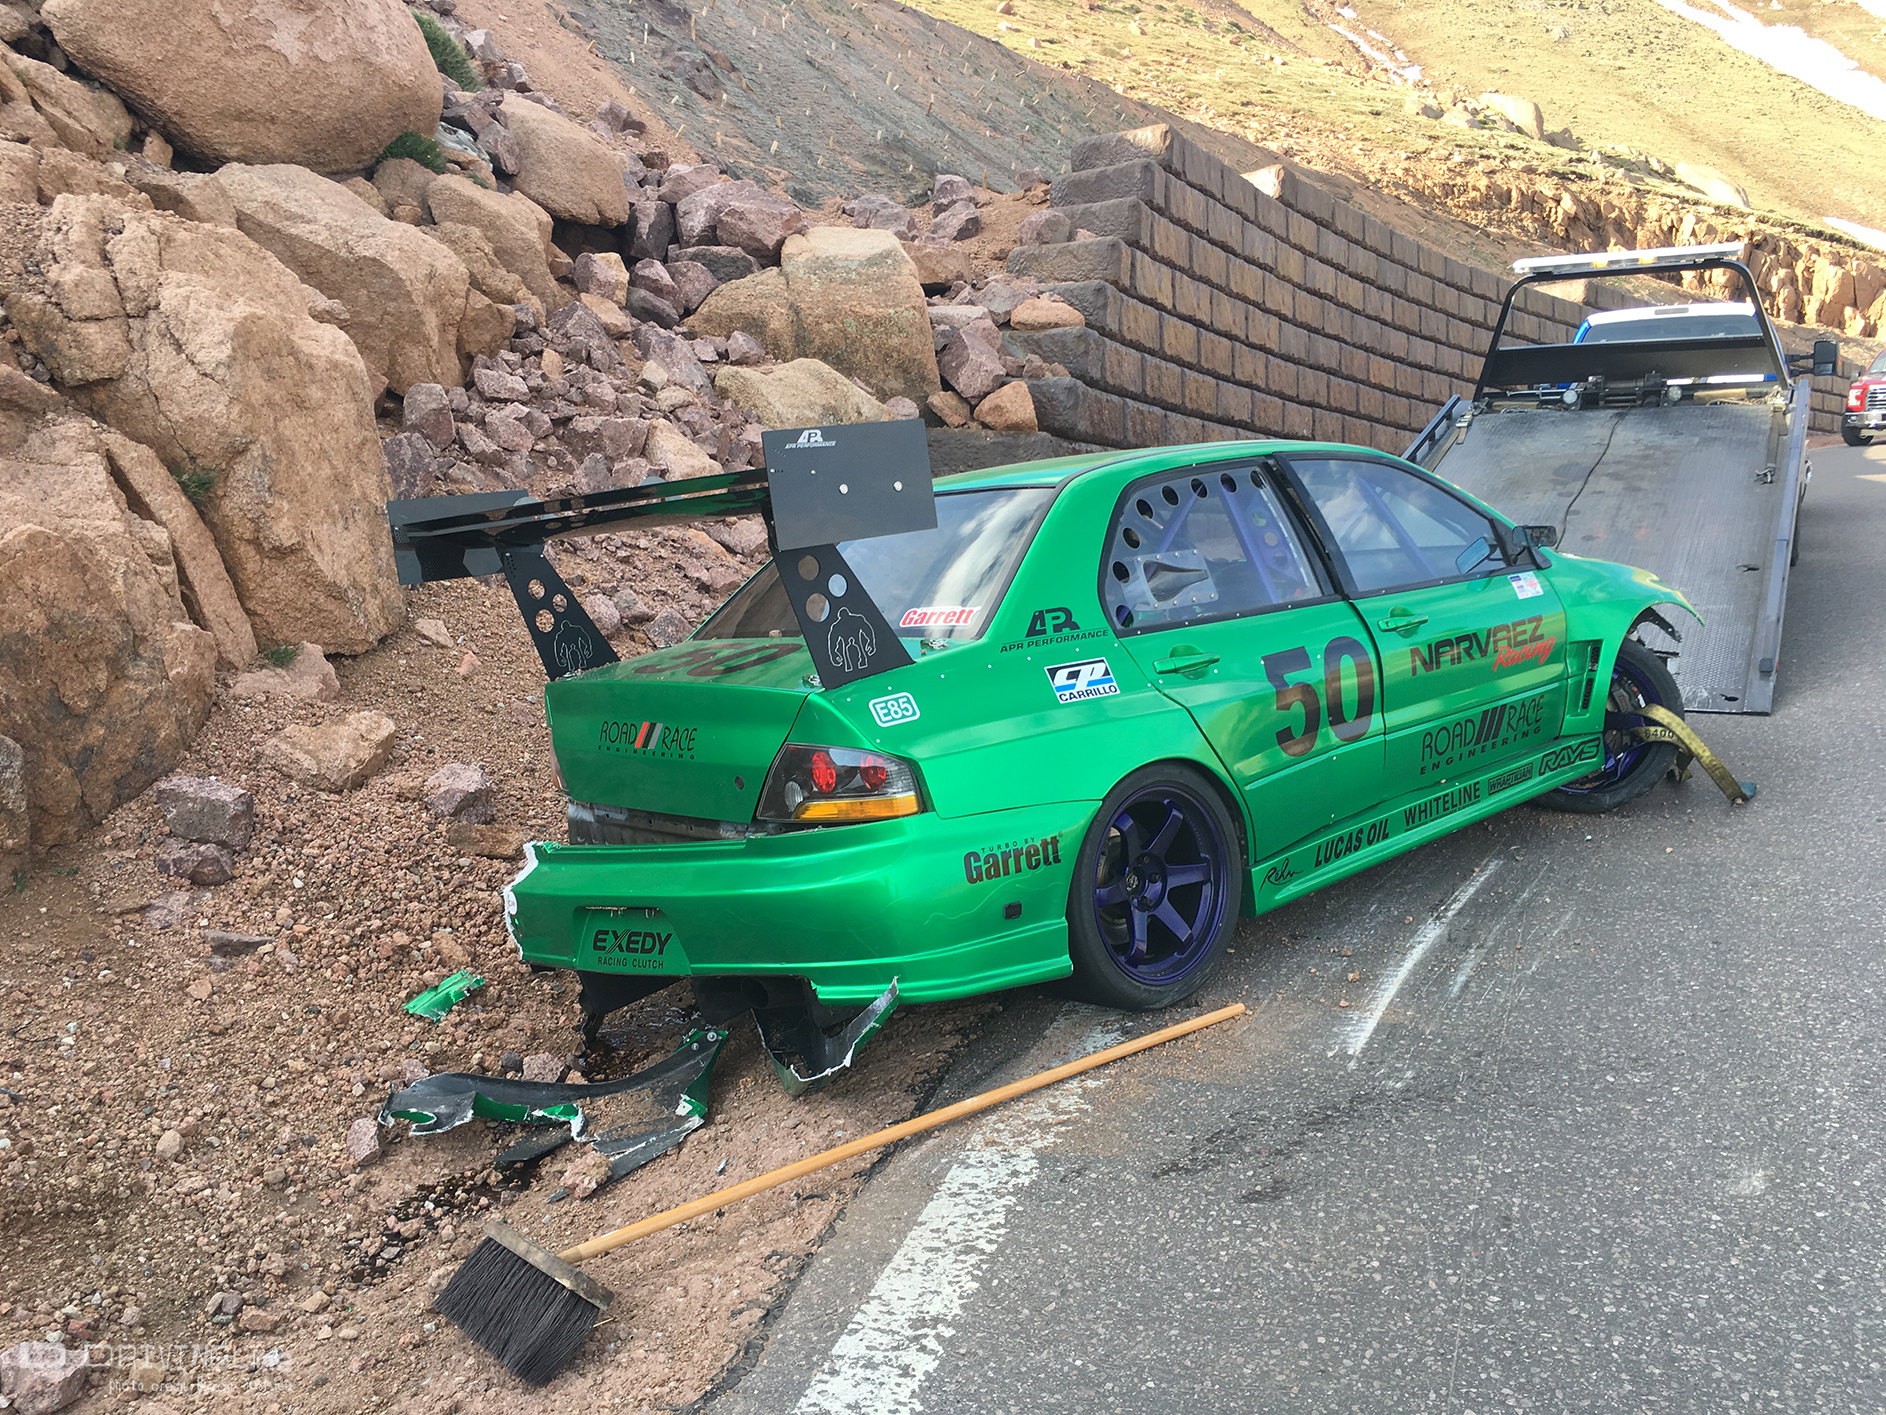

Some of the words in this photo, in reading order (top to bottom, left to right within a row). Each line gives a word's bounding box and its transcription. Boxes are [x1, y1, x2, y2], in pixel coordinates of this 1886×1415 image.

[901, 608, 975, 627] Garrett
[1025, 606, 1082, 639] APR
[999, 641, 1024, 653] APR
[1027, 629, 1109, 649] PERFORMANCE
[1409, 613, 1545, 677] NARVAEZ
[1492, 637, 1557, 673] Racing
[633, 642, 804, 677] 50
[874, 697, 914, 722] E85
[1058, 684, 1118, 702] CARRILLO
[1260, 635, 1375, 757] 50
[599, 720, 638, 745] ROAD
[661, 725, 698, 751] RACE
[1421, 718, 1476, 762] ROAD
[1505, 694, 1545, 734] RACE
[598, 744, 695, 760] ENGINEERING
[1419, 725, 1541, 776] ENGINEERING
[1538, 736, 1601, 777] RAYS
[1404, 781, 1480, 827] WHITELINE
[963, 836, 1061, 884] Garrett
[981, 840, 1018, 854] TURBO
[1024, 837, 1036, 845] BY
[1314, 827, 1364, 868] LUCAS
[1366, 818, 1390, 846] OIL
[592, 928, 674, 956] EXEDY
[597, 956, 628, 967] RACING
[631, 958, 664, 969] CLUTCH
